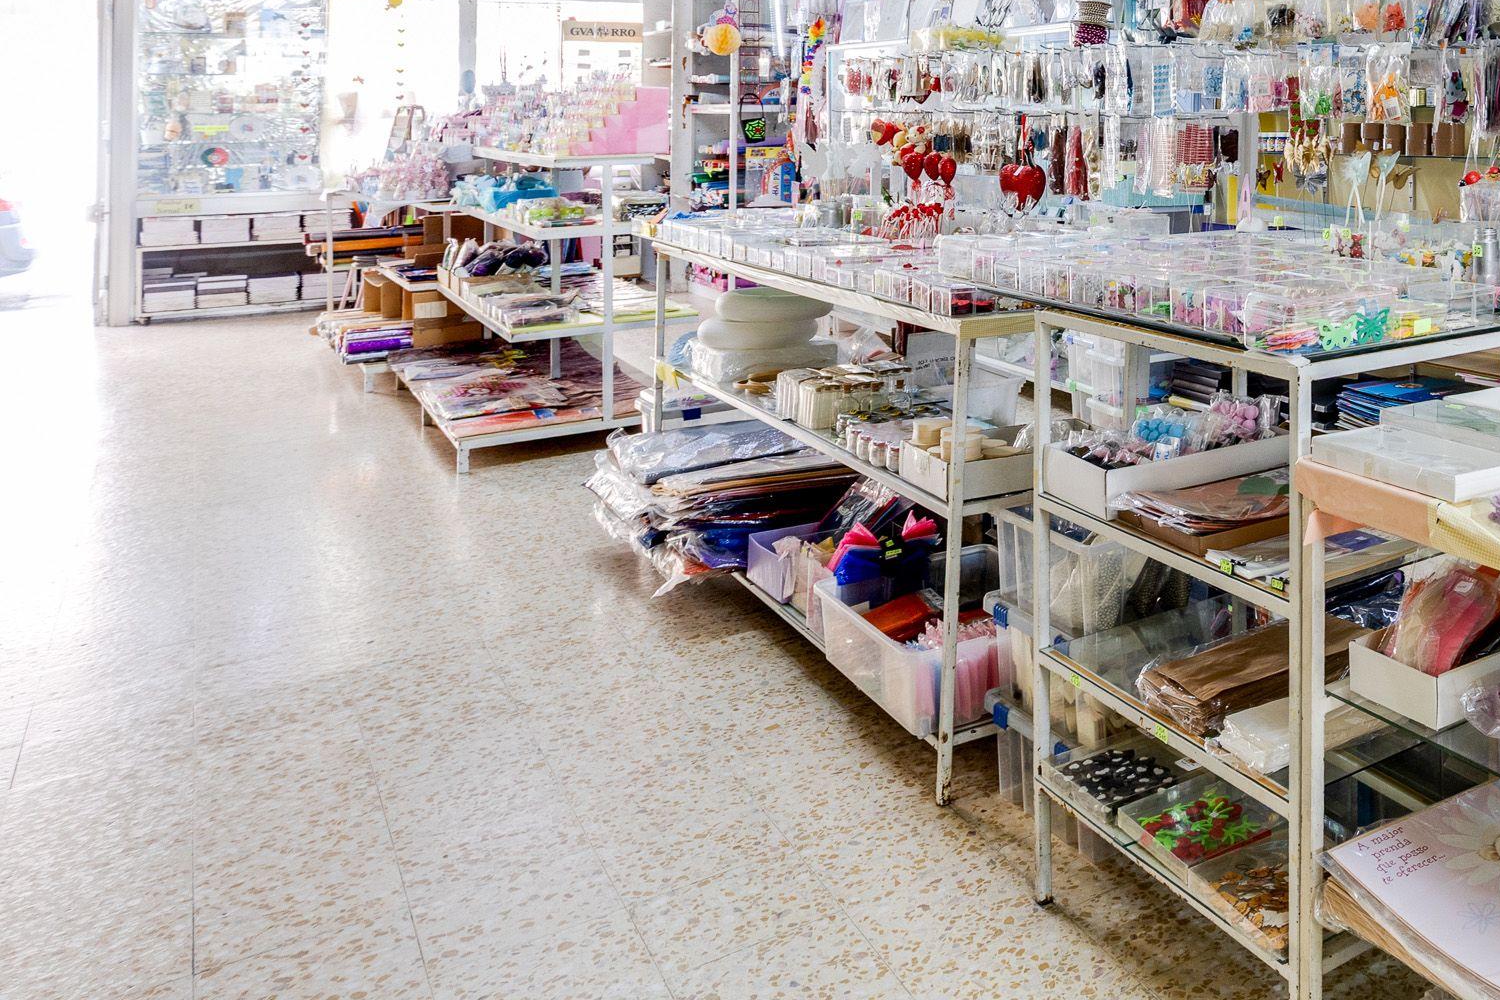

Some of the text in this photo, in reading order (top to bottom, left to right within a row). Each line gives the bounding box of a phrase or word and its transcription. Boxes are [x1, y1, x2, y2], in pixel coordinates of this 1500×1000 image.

[1356, 826, 1404, 852] A maior
[1371, 838, 1412, 862] prenda
[1376, 845, 1429, 874] que posso
